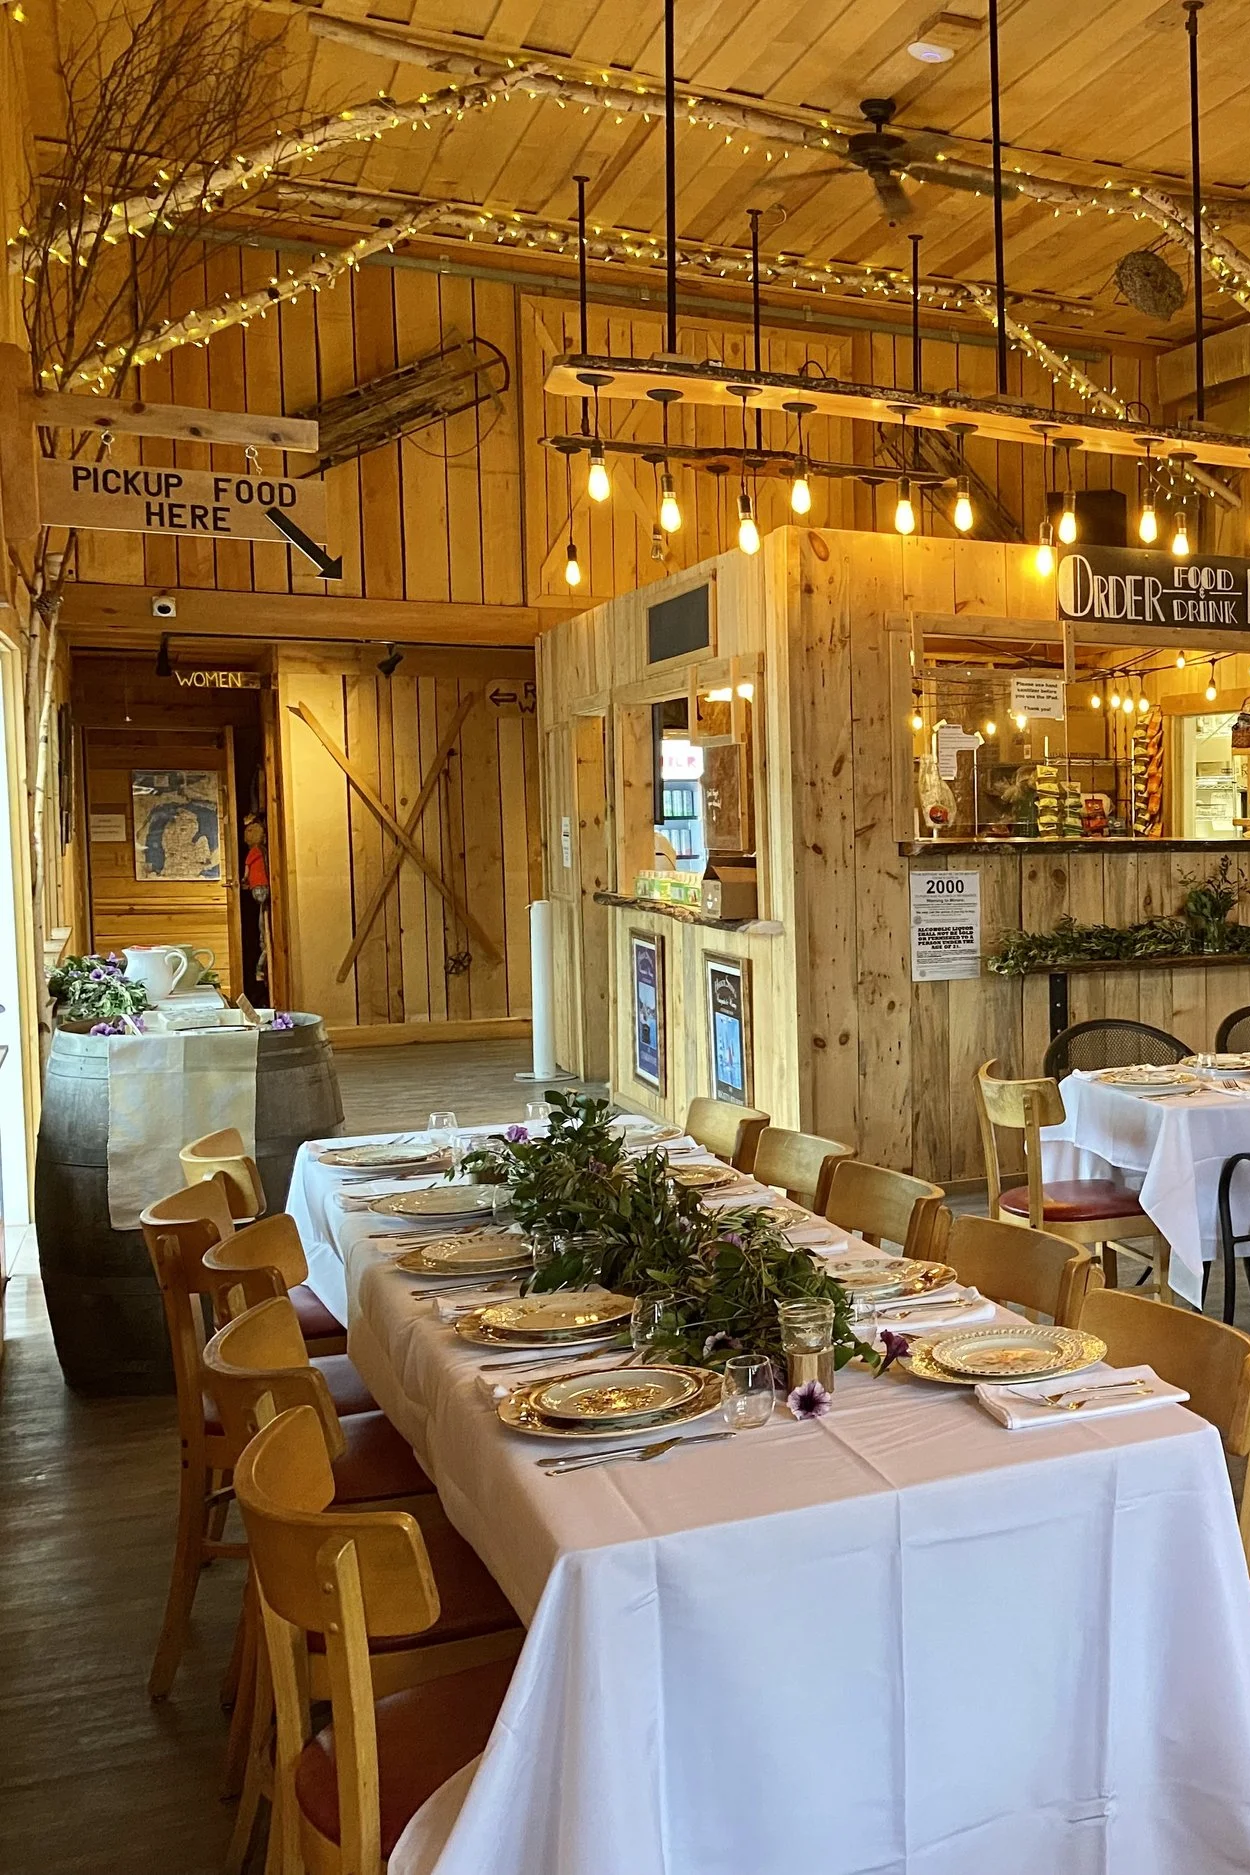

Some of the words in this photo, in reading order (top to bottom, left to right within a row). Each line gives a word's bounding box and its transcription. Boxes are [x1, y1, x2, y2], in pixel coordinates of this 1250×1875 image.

[72, 466, 183, 498] PICKUP
[213, 477, 297, 508] FOOD
[145, 501, 231, 532] HERE
[1058, 554, 1166, 622] ORDER
[1173, 566, 1234, 591] FOOD
[1173, 600, 1239, 624] DRINK
[174, 671, 242, 688] WOMEN
[926, 880, 965, 894] 2000
